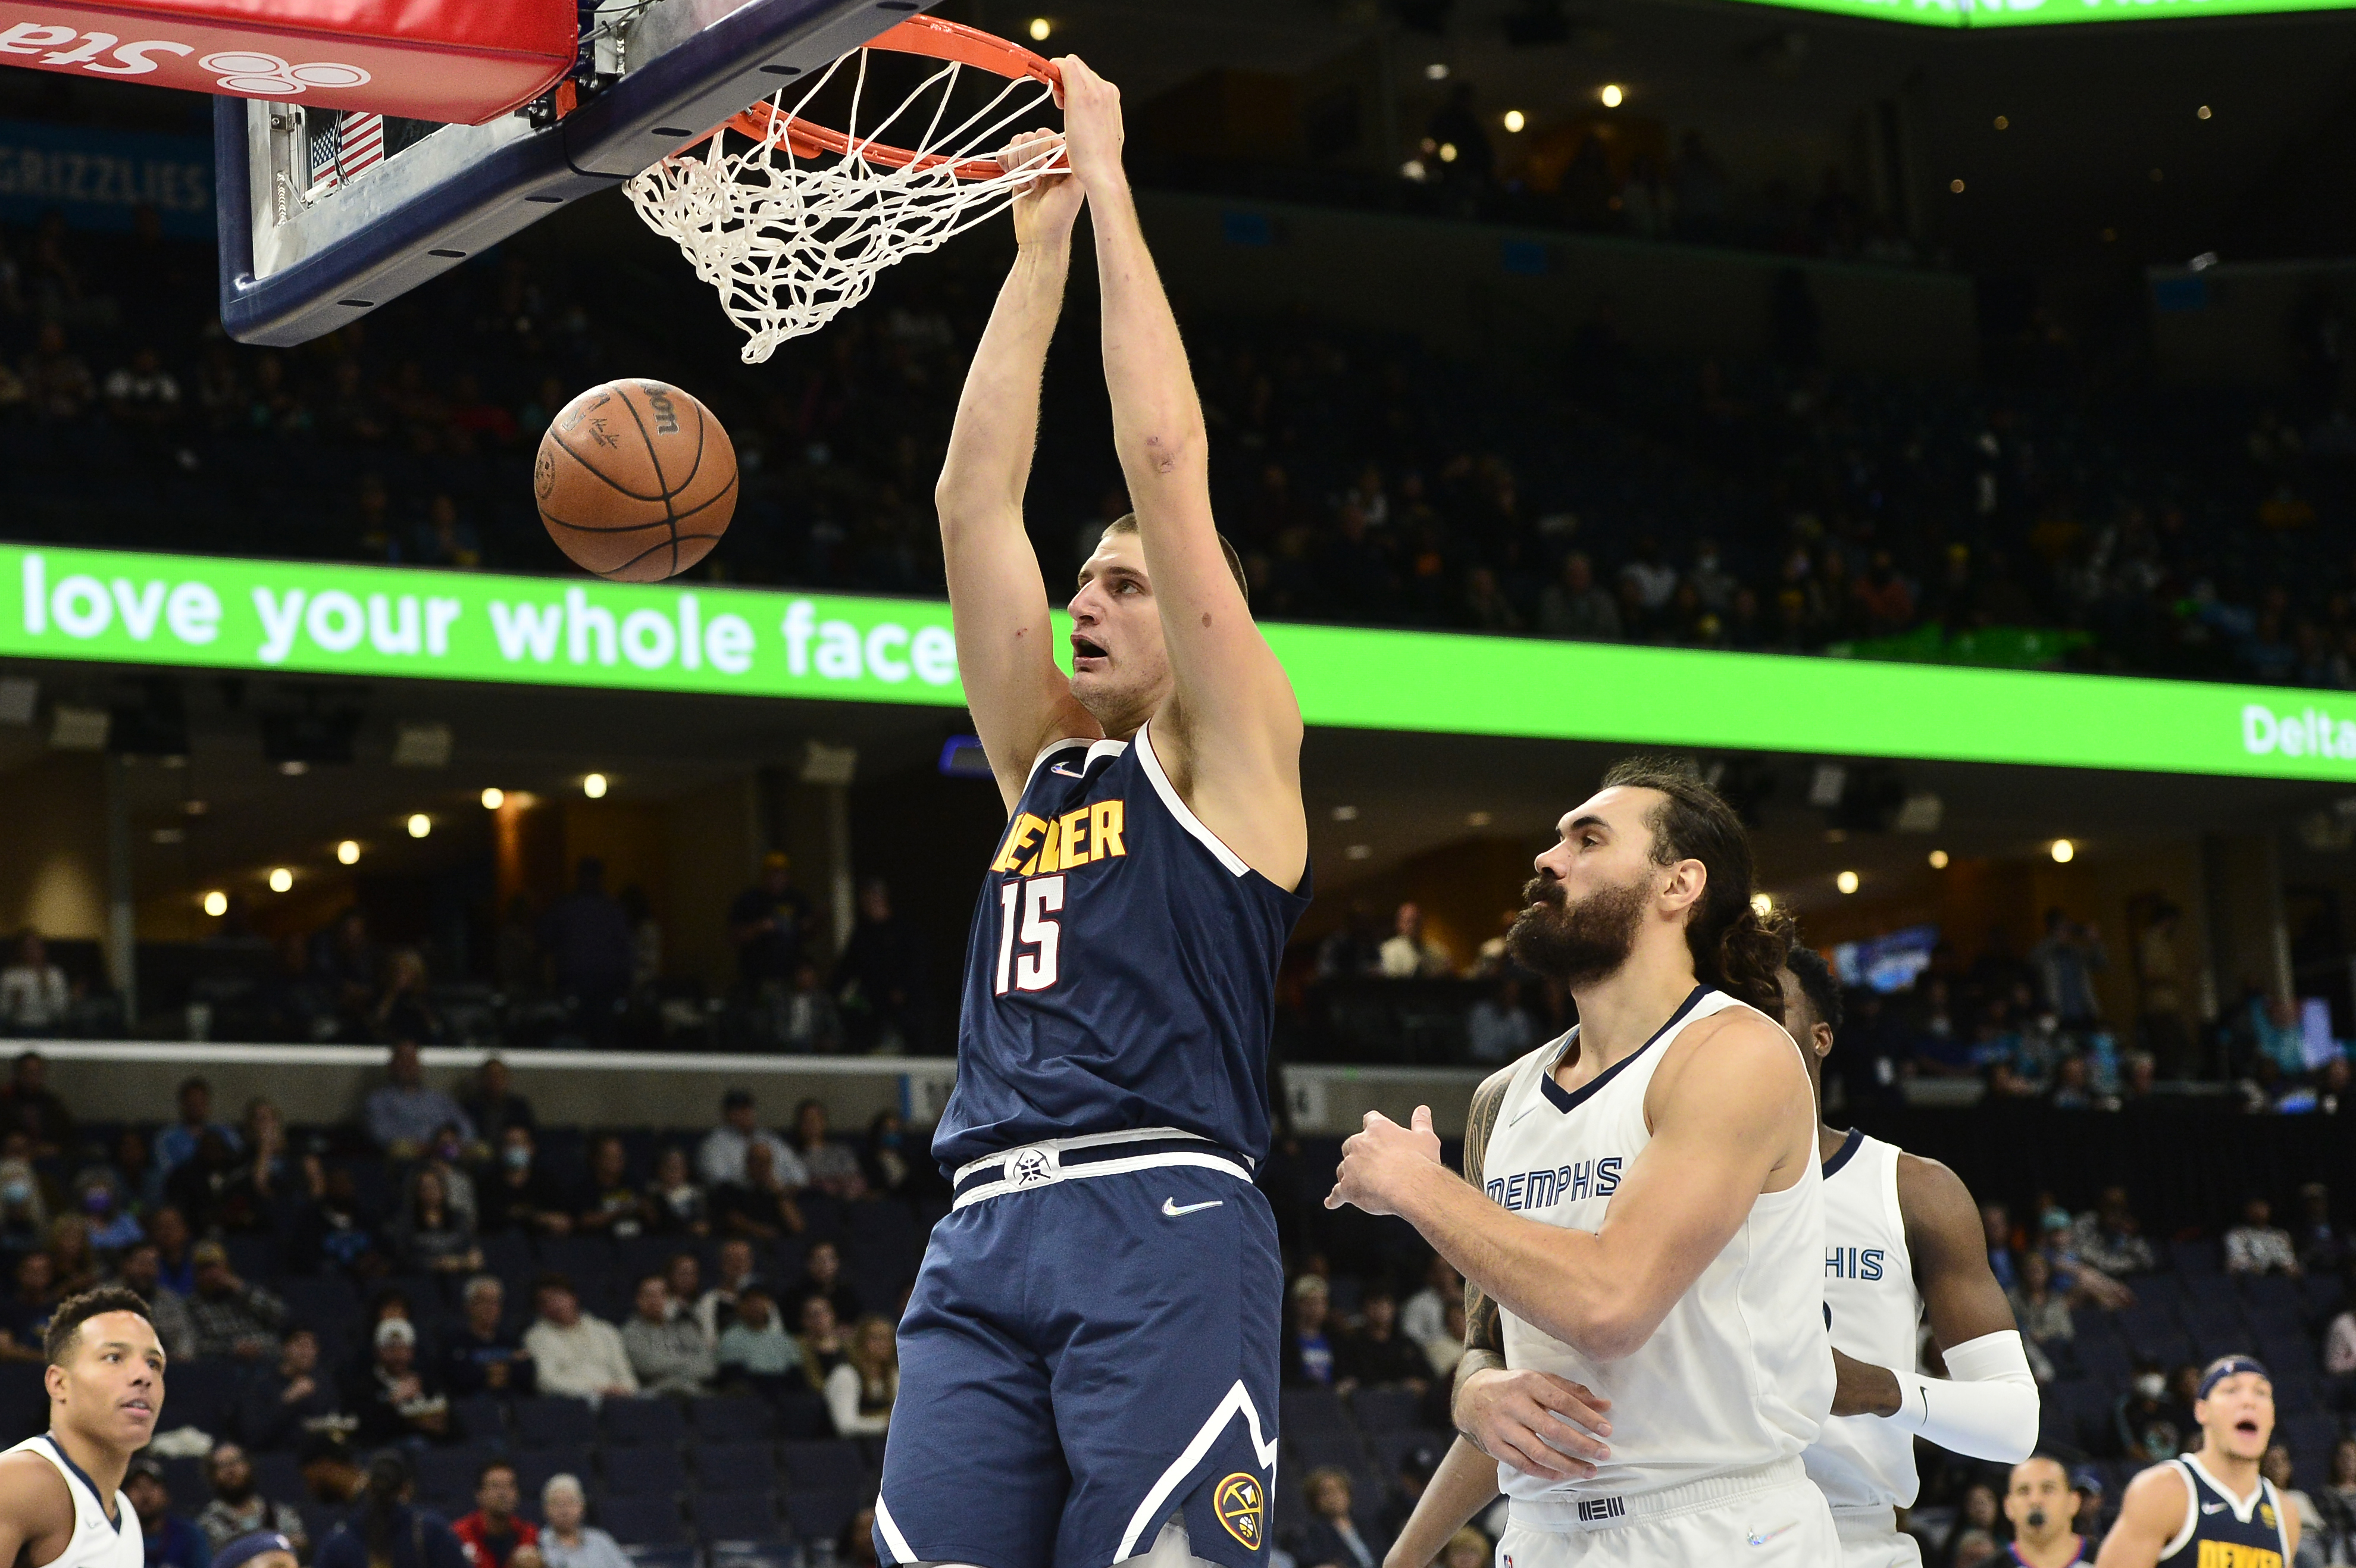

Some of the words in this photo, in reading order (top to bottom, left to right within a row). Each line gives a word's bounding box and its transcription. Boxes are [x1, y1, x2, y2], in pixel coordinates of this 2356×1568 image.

[0, 22, 195, 74] Sta
[21, 554, 221, 645] love
[252, 586, 461, 663] your
[489, 587, 755, 674] whole
[782, 600, 958, 685] face
[2241, 705, 2356, 759] Delta
[990, 799, 1127, 877] EER
[996, 873, 1065, 997] 15
